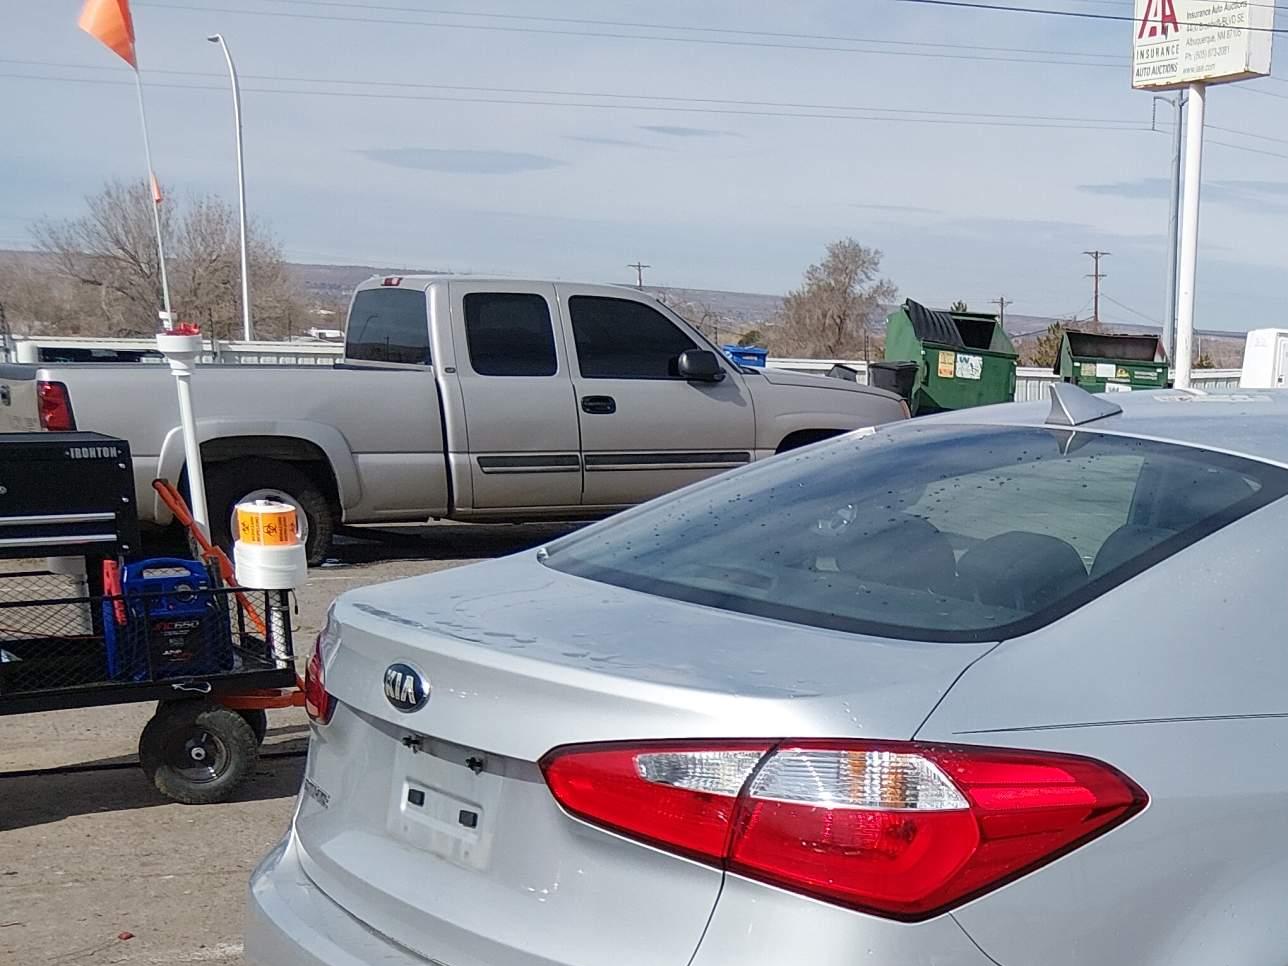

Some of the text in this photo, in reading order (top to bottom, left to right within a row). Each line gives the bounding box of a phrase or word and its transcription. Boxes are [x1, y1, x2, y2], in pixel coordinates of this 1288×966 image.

[1137, 44, 1180, 60] INSURANCE
[1136, 64, 1178, 77] AUTO AUCTIONS
[70, 447, 117, 459] IRONTON
[385, 669, 416, 705] KIA
